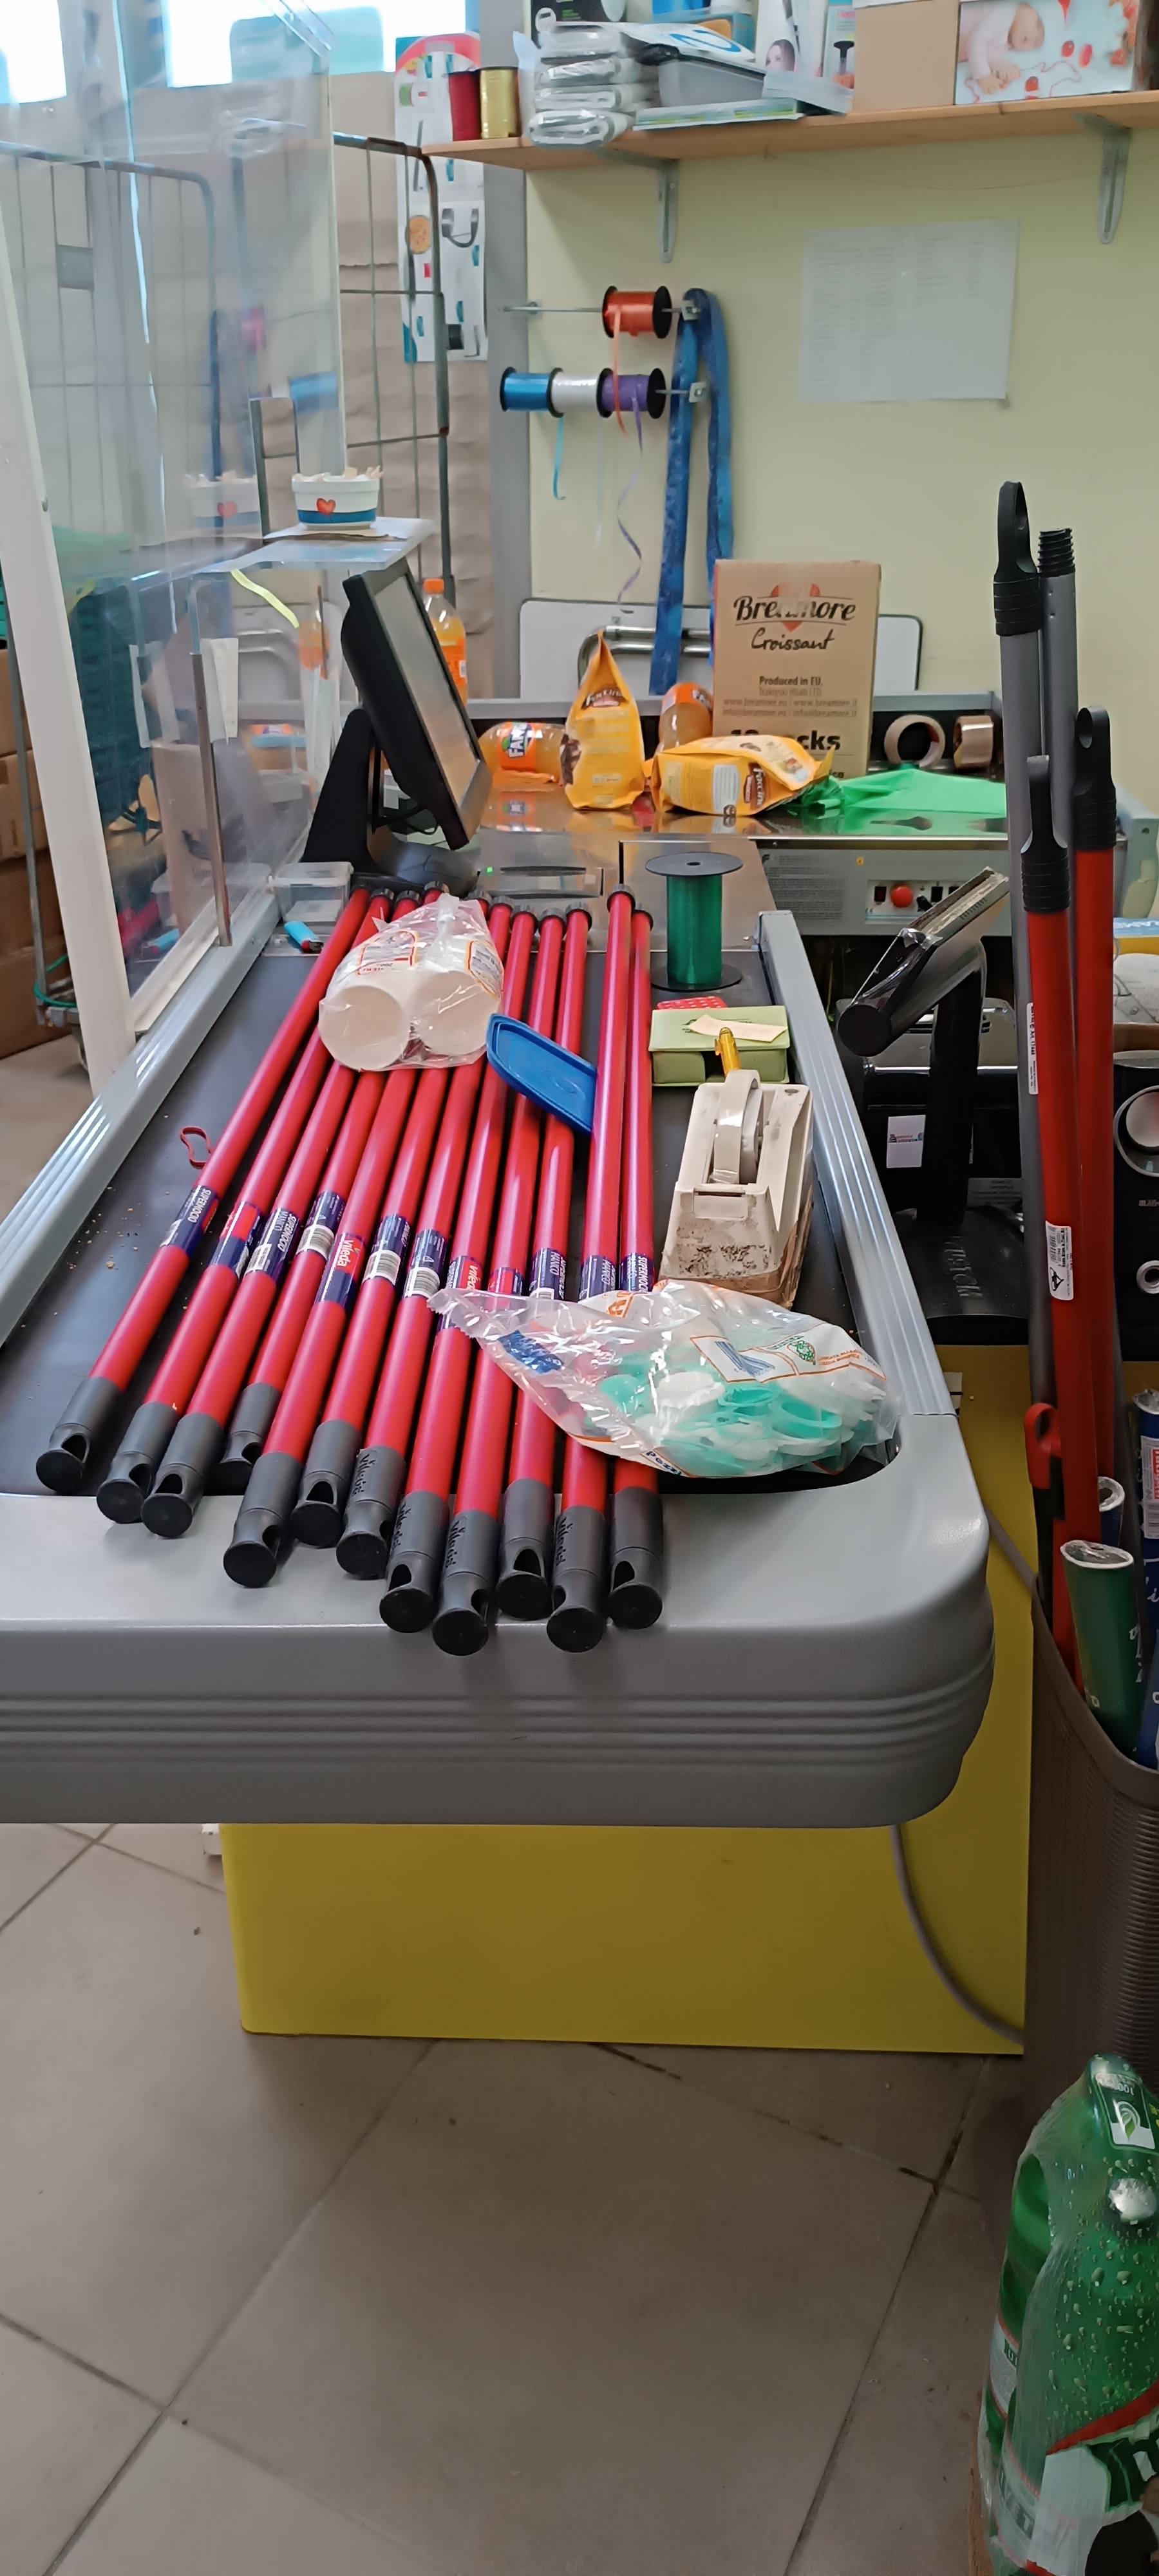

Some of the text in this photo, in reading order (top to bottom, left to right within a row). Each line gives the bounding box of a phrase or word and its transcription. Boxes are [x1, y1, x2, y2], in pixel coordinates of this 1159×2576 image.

[751, 627, 836, 650] Croissant
[759, 676, 798, 686] Produced
[800, 676, 808, 686] in
[278, 1213, 297, 1252] SUPERMOCIO
